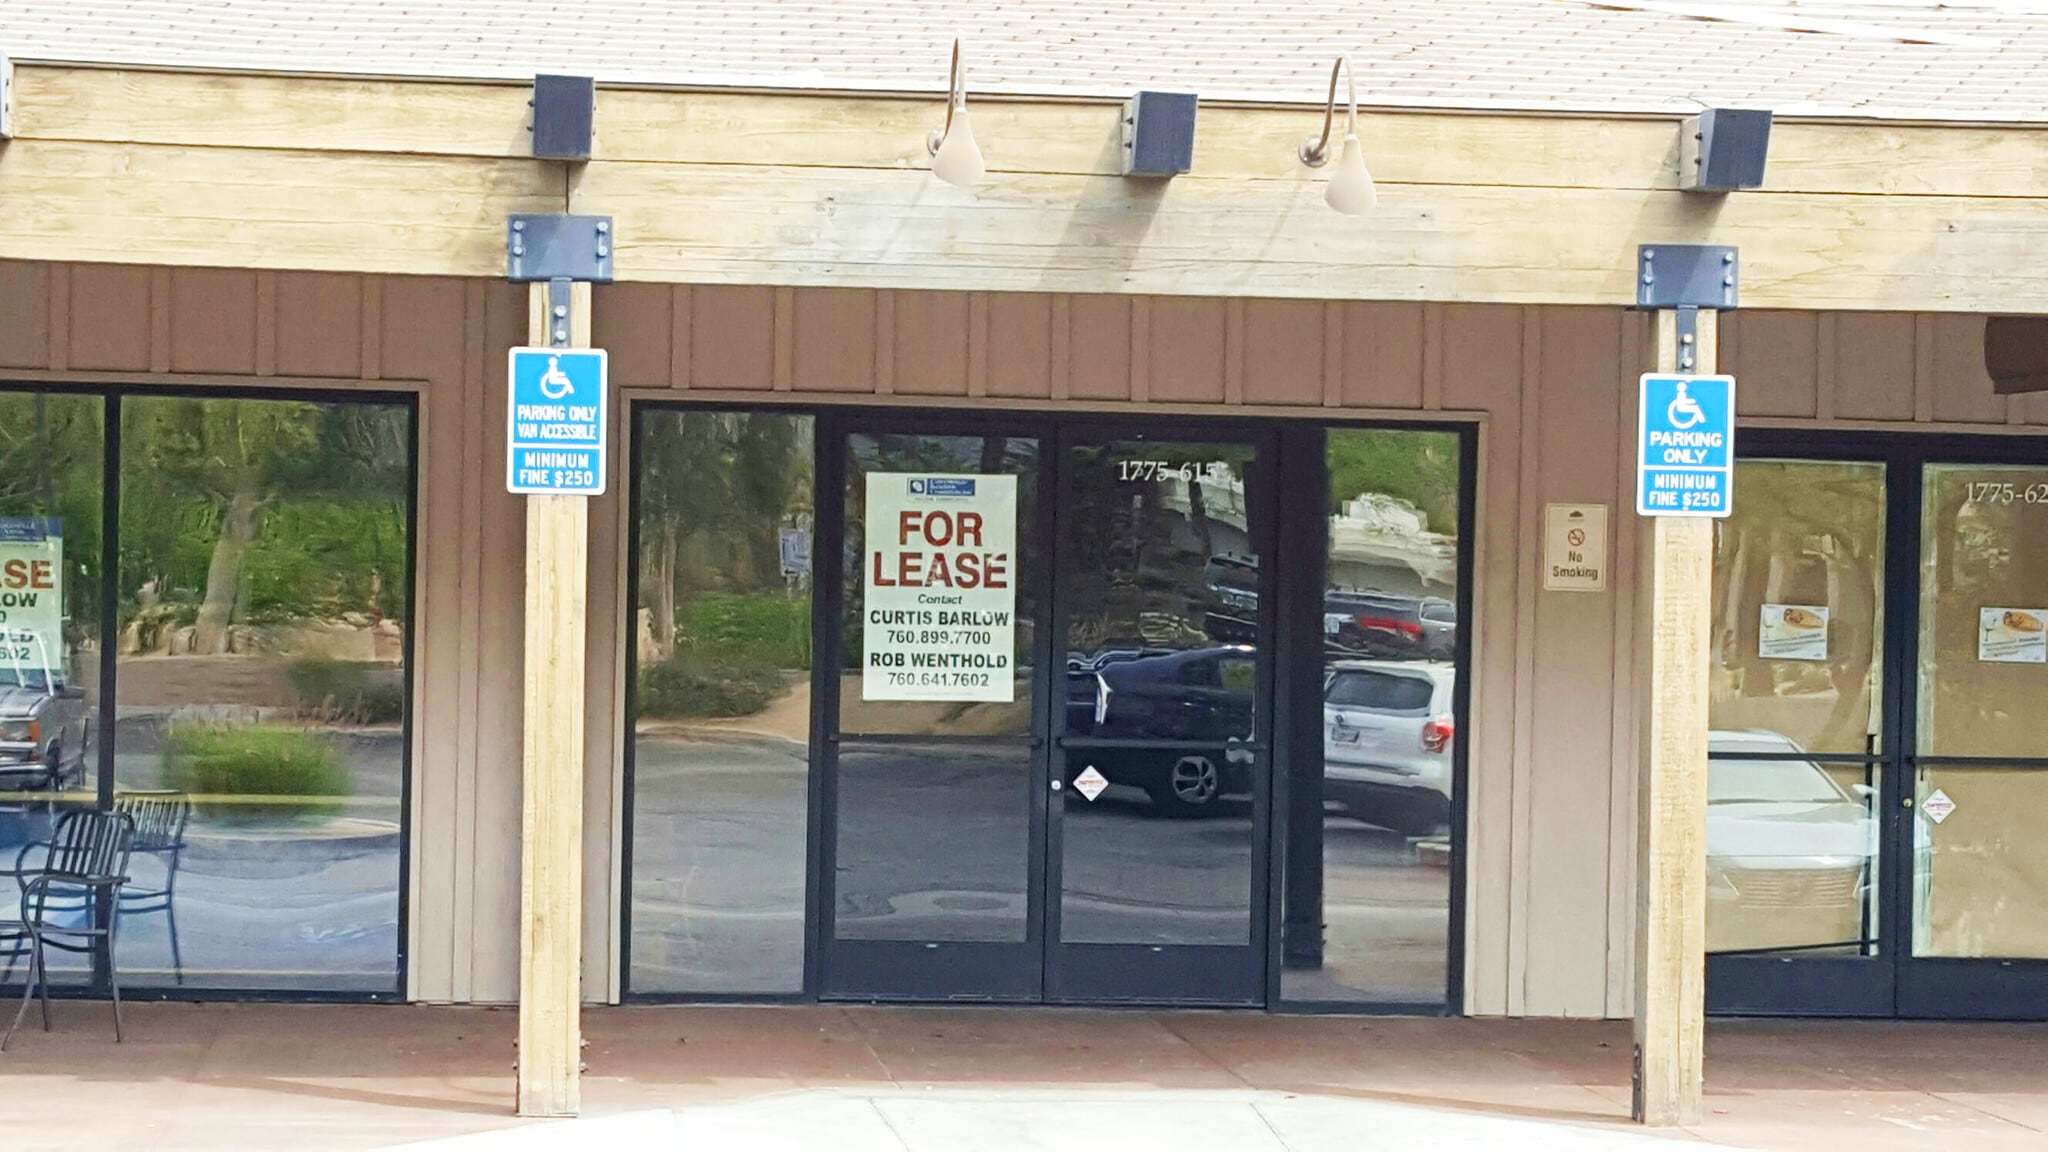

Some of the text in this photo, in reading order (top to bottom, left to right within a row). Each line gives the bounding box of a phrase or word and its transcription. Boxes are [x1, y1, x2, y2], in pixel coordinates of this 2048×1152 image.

[517, 404, 597, 422] PARKING ONLY
[517, 422, 597, 440] VAN ACCESSIBLE
[1650, 431, 1722, 447] PARKING
[525, 452, 589, 468] MINIMUM
[1663, 448, 1708, 464] ONLY
[519, 469, 593, 487] FINE $250
[1654, 473, 1716, 490] MINIMUM
[1649, 490, 1720, 508] FINE $250
[899, 510, 983, 547] FOR
[1568, 550, 1583, 563] No
[0, 559, 54, 589] SE
[873, 551, 1008, 589] LEASE
[1552, 564, 1599, 581] Smoking
[917, 593, 963, 605] Contact
[870, 610, 1009, 627] CURTIS BARLOW
[887, 630, 992, 645] 760.899.7700
[870, 652, 1008, 668] ROB WENTHOLD
[888, 672, 990, 687] 760.641.7602
